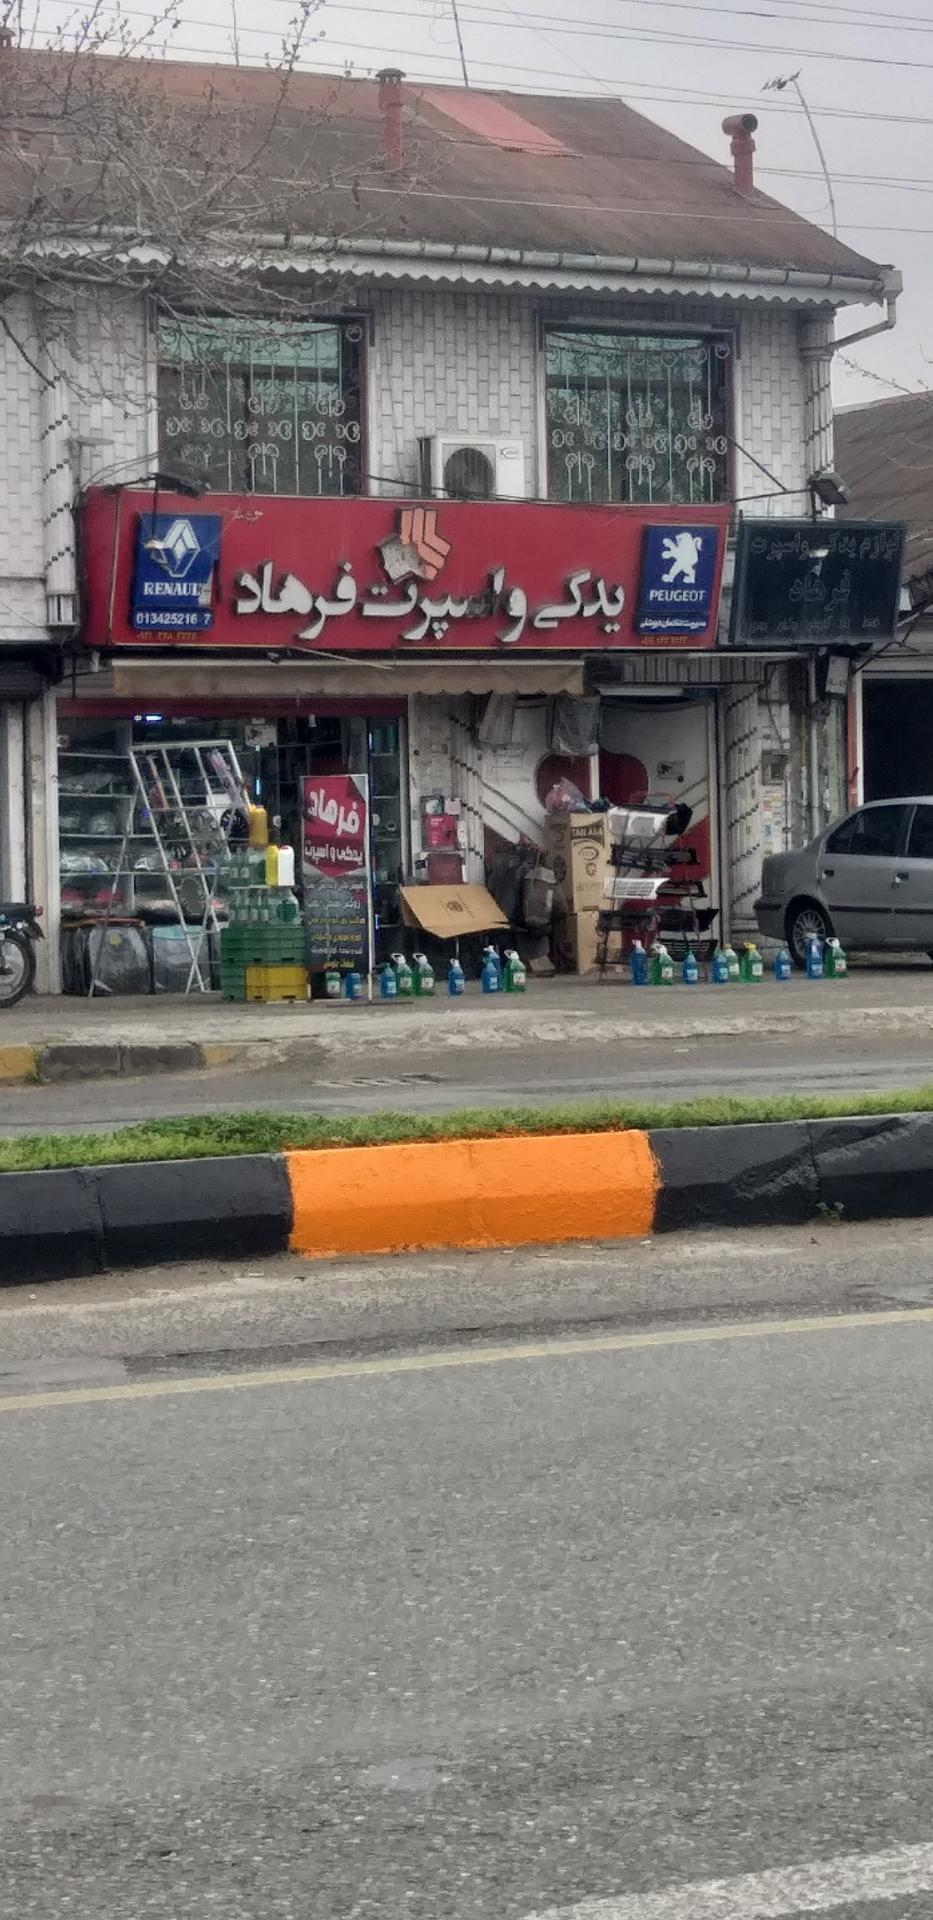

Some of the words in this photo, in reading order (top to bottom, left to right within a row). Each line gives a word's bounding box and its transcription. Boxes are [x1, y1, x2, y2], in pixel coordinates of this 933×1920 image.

[751, 531, 801, 561] اسپرت
[798, 540, 810, 560] و
[859, 529, 900, 562] لوازم
[143, 582, 211, 596] RENAUL
[235, 560, 357, 641] فرهاد
[362, 567, 505, 641] اسپرت
[534, 568, 625, 634] یدکی
[649, 589, 706, 602] PEUGEOT
[788, 567, 851, 613] فرهاد
[136, 612, 211, 625] 0134252167
[498, 587, 527, 643] و
[307, 787, 361, 837] فرهاد
[304, 839, 330, 865] اسپرت
[329, 846, 336, 863] و
[336, 846, 363, 866] یدکی
